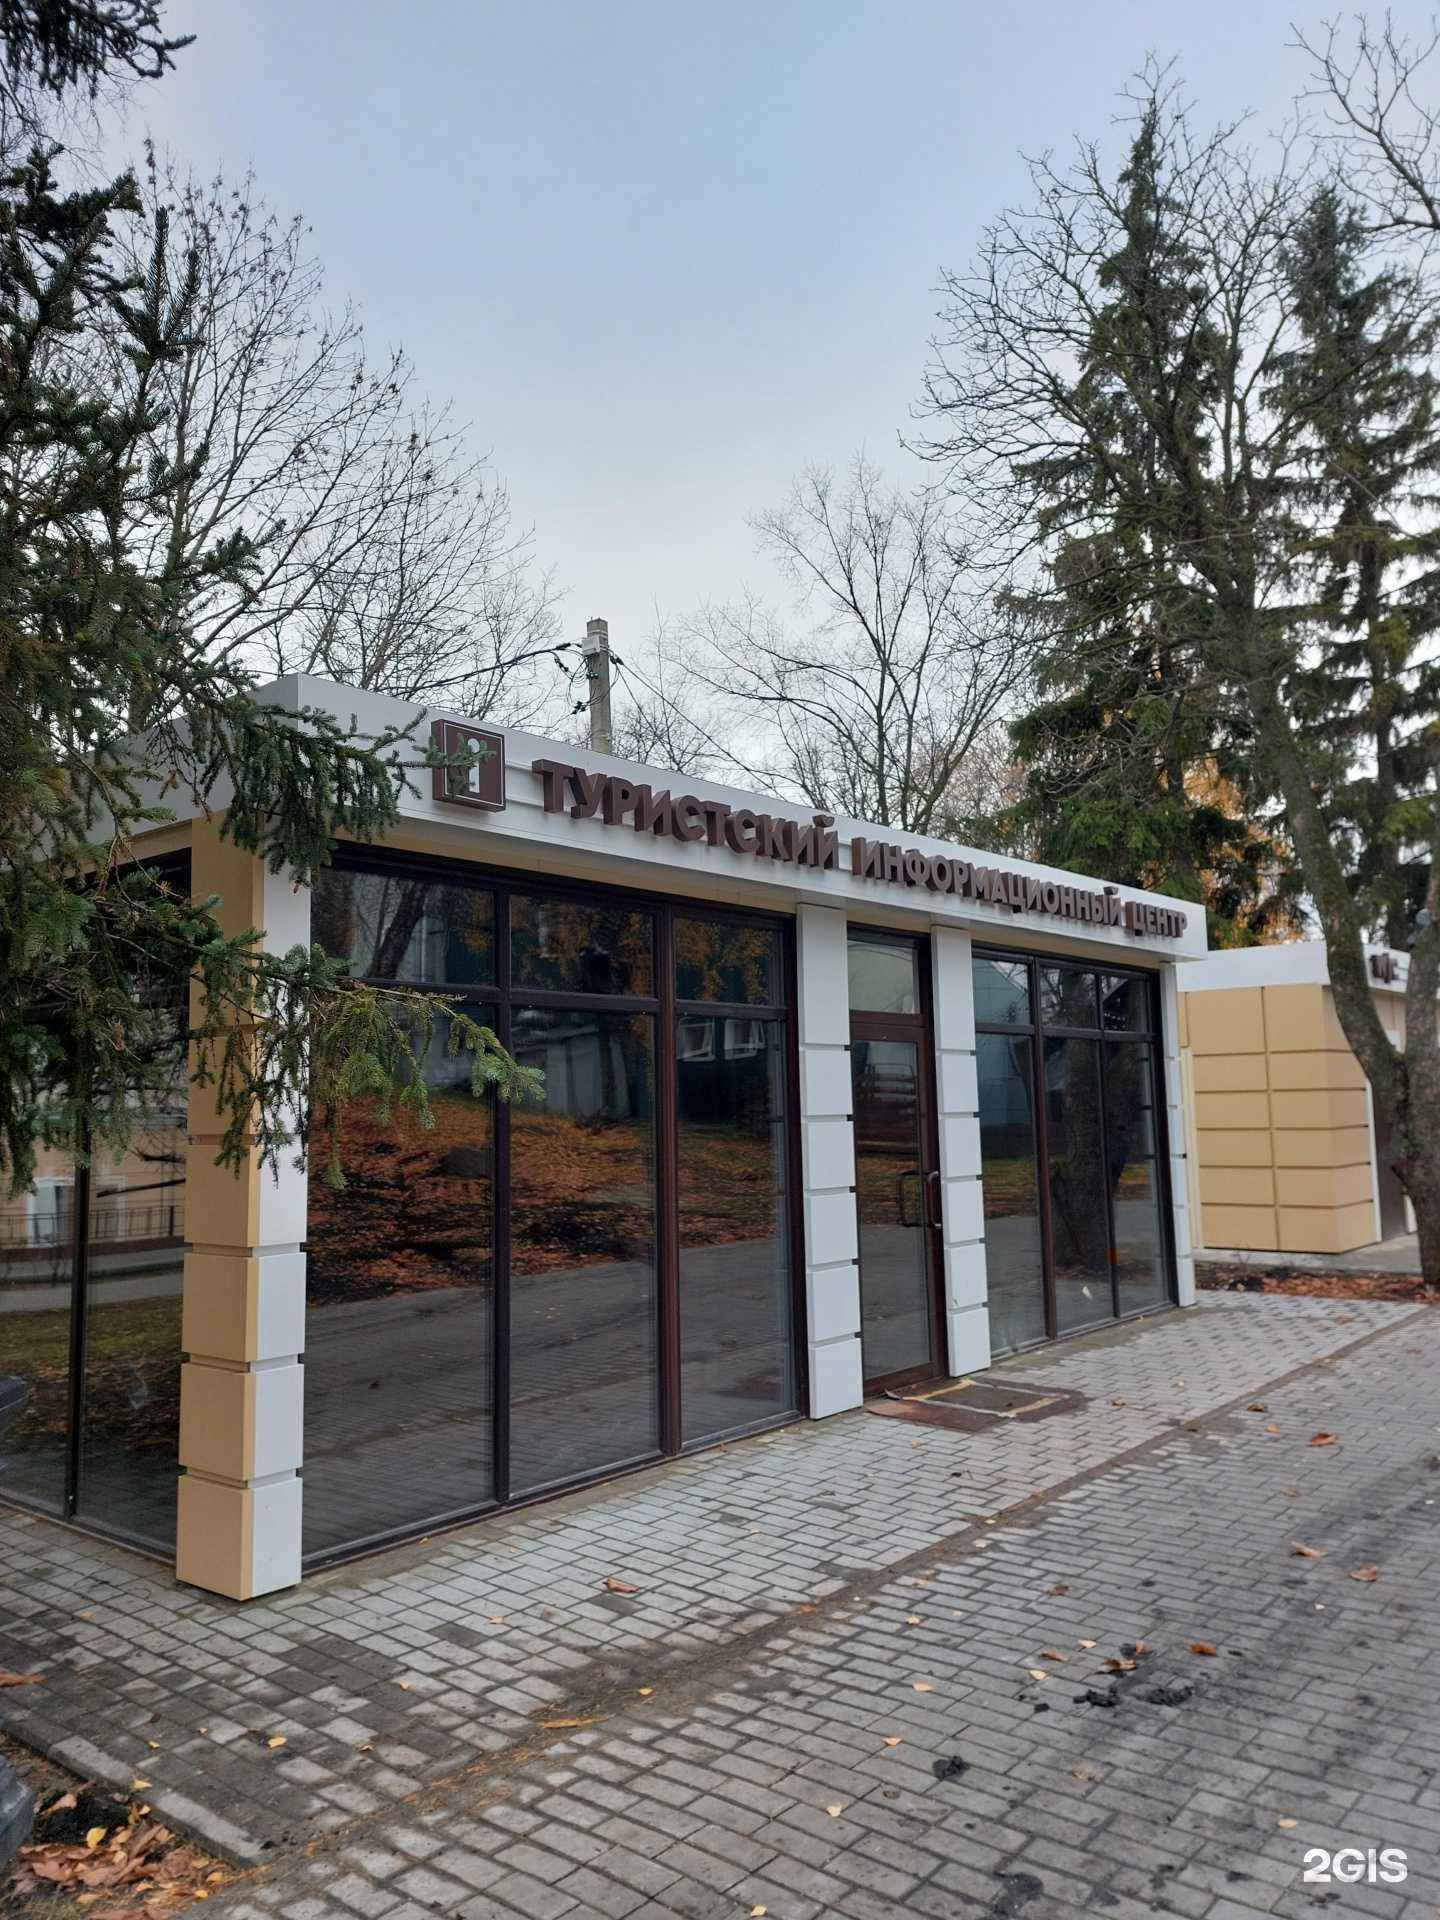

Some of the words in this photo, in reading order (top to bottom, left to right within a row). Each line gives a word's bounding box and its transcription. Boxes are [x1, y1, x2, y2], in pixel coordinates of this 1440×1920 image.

[532, 758, 839, 870] ТУРИСТСКИЙ
[852, 836, 1122, 927] ИНФОРМАЦИОННЫЙ
[1125, 901, 1188, 938] ЦЕНТР
